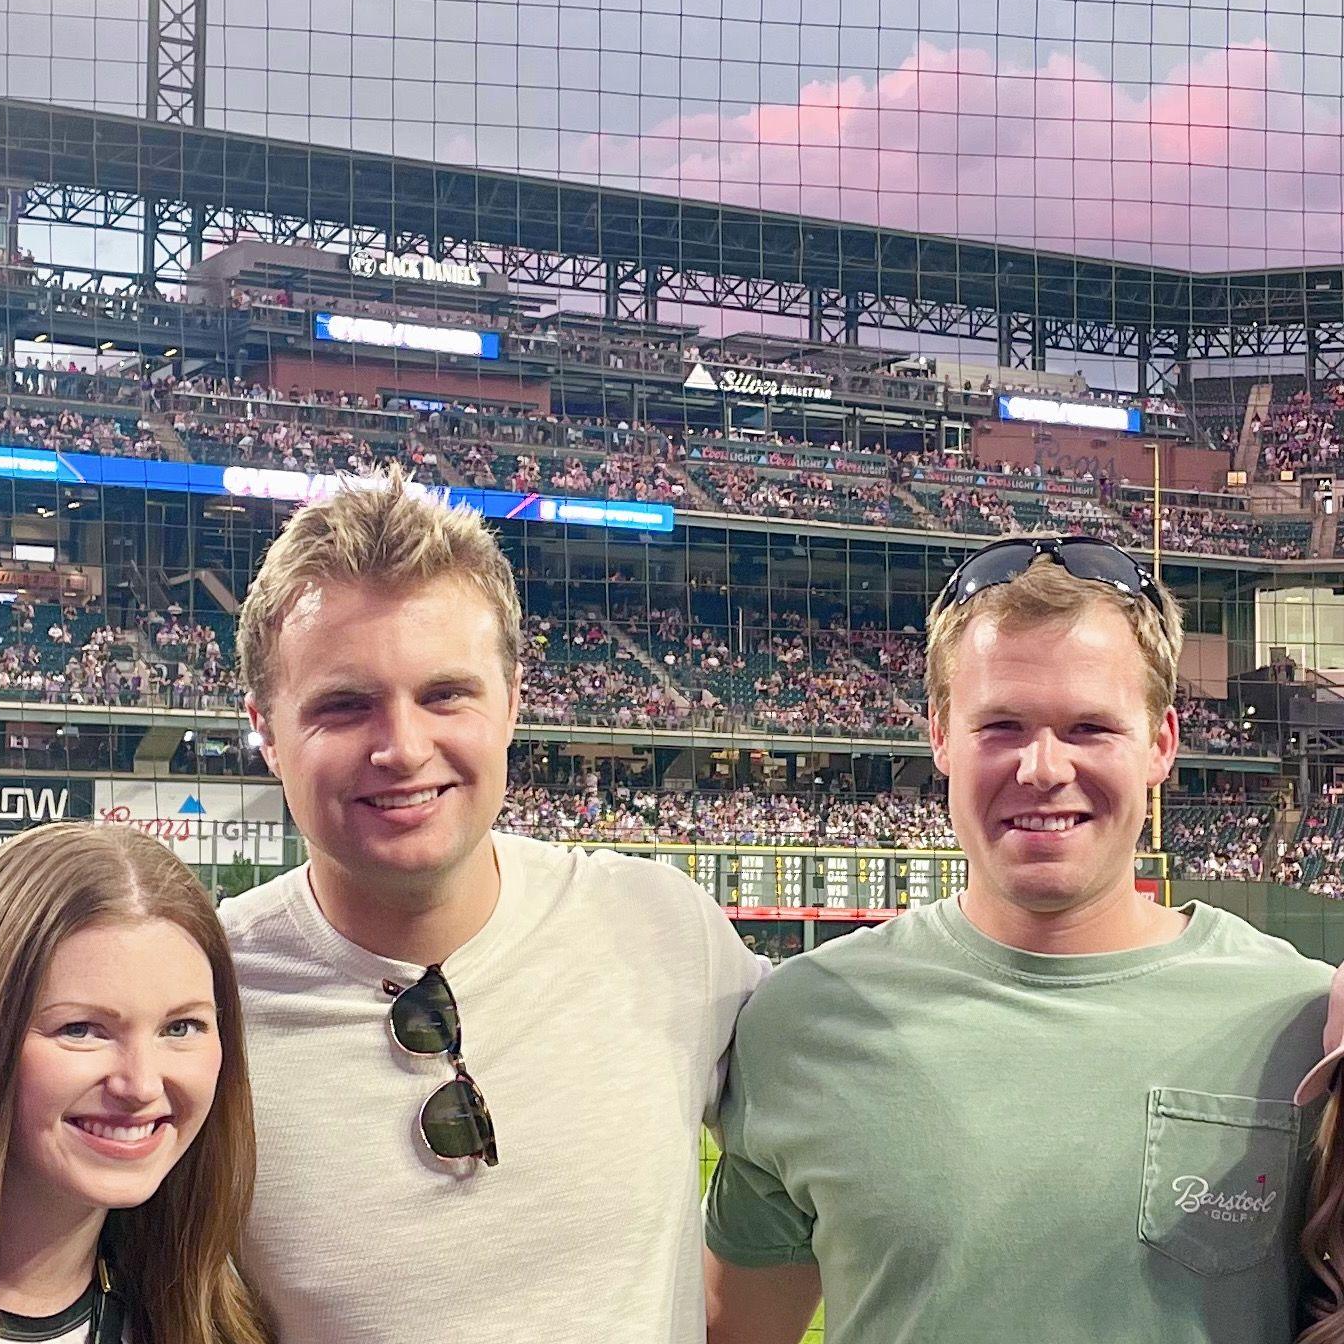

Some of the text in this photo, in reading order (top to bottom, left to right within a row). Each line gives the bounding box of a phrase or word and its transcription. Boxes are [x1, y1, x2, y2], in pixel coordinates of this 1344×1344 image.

[379, 252, 421, 278] JACK
[720, 370, 780, 396] Silver
[197, 819, 278, 841] LIGHT
[1172, 1175, 1277, 1213] Barstool
[1211, 1209, 1248, 1223] GOLF
